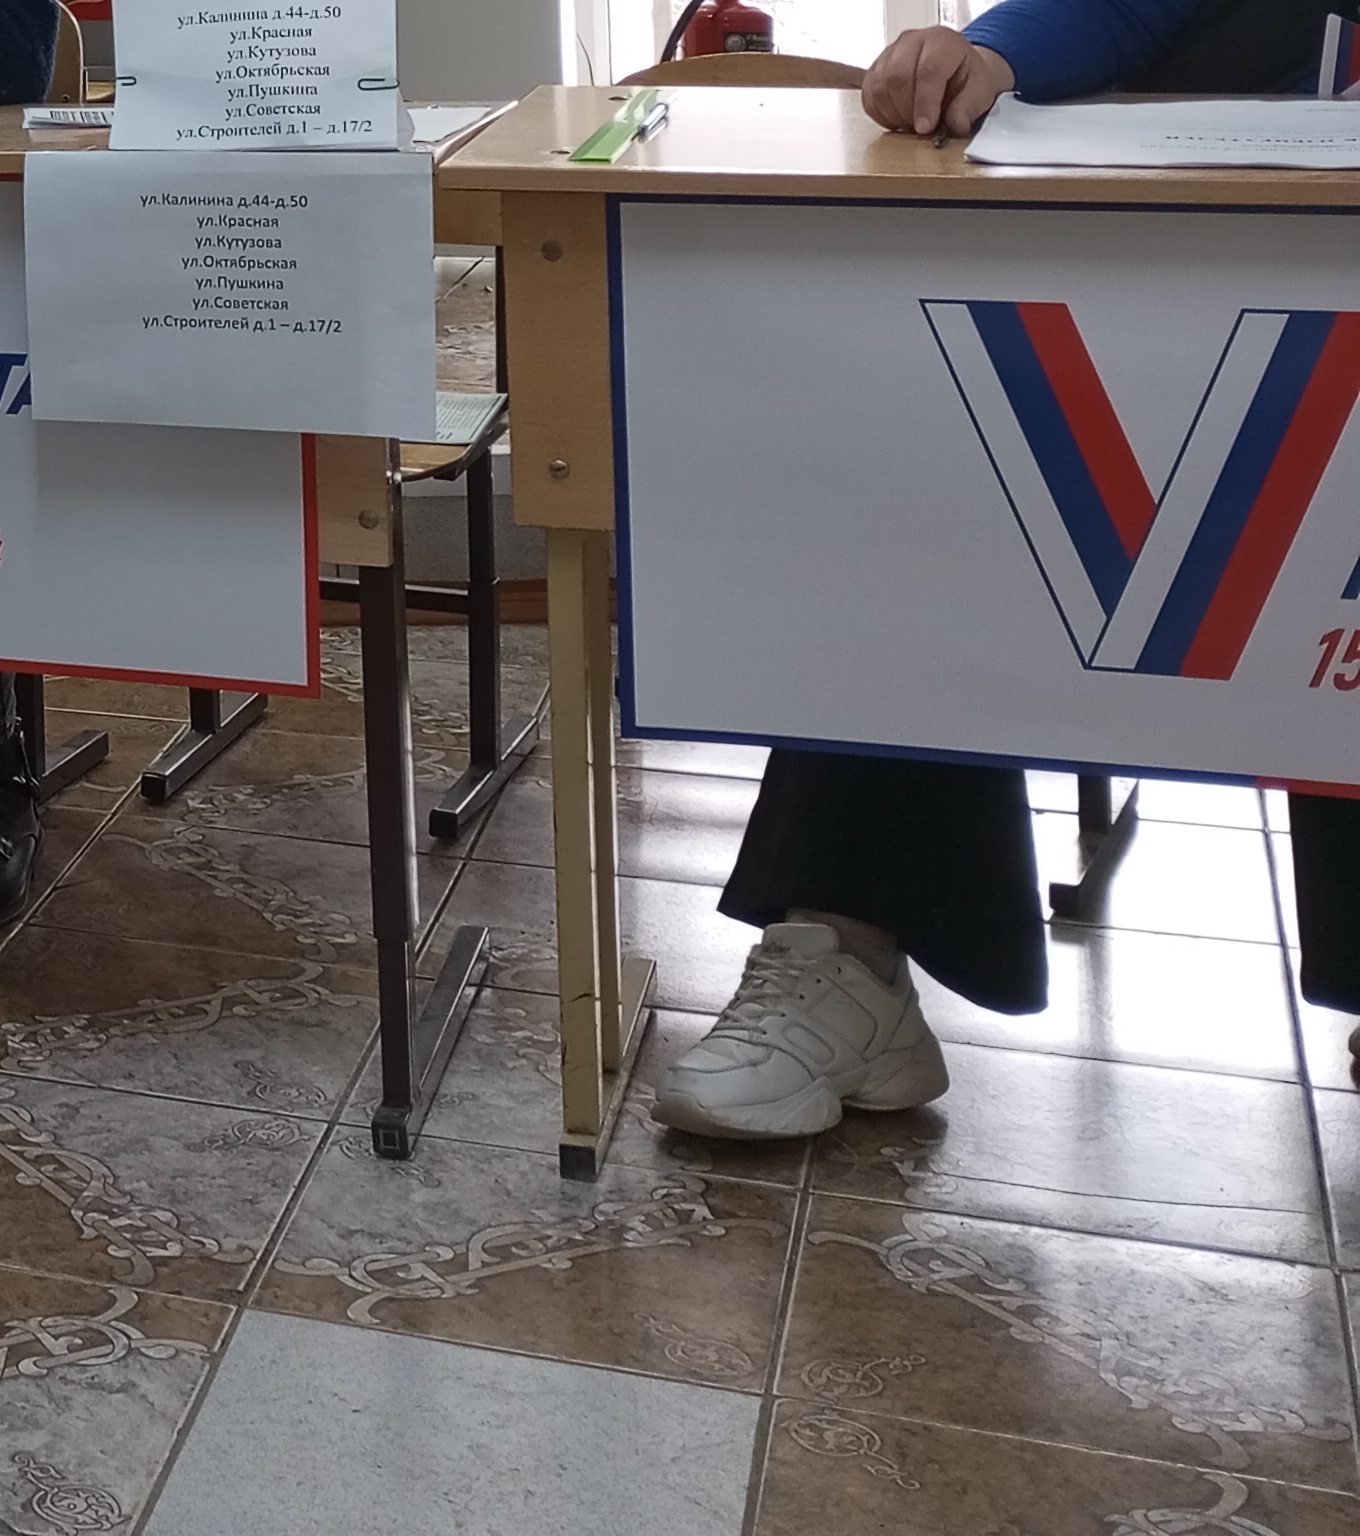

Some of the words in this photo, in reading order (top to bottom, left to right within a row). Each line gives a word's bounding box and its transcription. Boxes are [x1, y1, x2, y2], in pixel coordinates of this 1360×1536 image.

[177, 10, 268, 29] ул.Калинина
[272, 5, 342, 21] д.44-д.50
[229, 26, 313, 44] ул.Красная
[227, 45, 317, 63] ул.Кутузова
[215, 64, 331, 83] ул.Октябрьская
[227, 84, 318, 102] ул.Пушкина
[225, 103, 321, 121] ул.Советская
[176, 121, 282, 141] ул.Строителей
[286, 120, 307, 135] д.1
[326, 120, 373, 135] д.17/2
[140, 193, 234, 208] ул.Калинина
[237, 194, 308, 209] д.44-д.50
[197, 214, 279, 229] ул.Красная
[195, 235, 283, 250] ул.Кутузова
[181, 255, 298, 271] ул.Октябрьская
[195, 276, 284, 291] ул.Пушкина
[192, 296, 289, 311] ул.Советская
[142, 315, 249, 330] ул.Строителей
[253, 318, 276, 333] д.1
[293, 320, 342, 335] д.17/2
